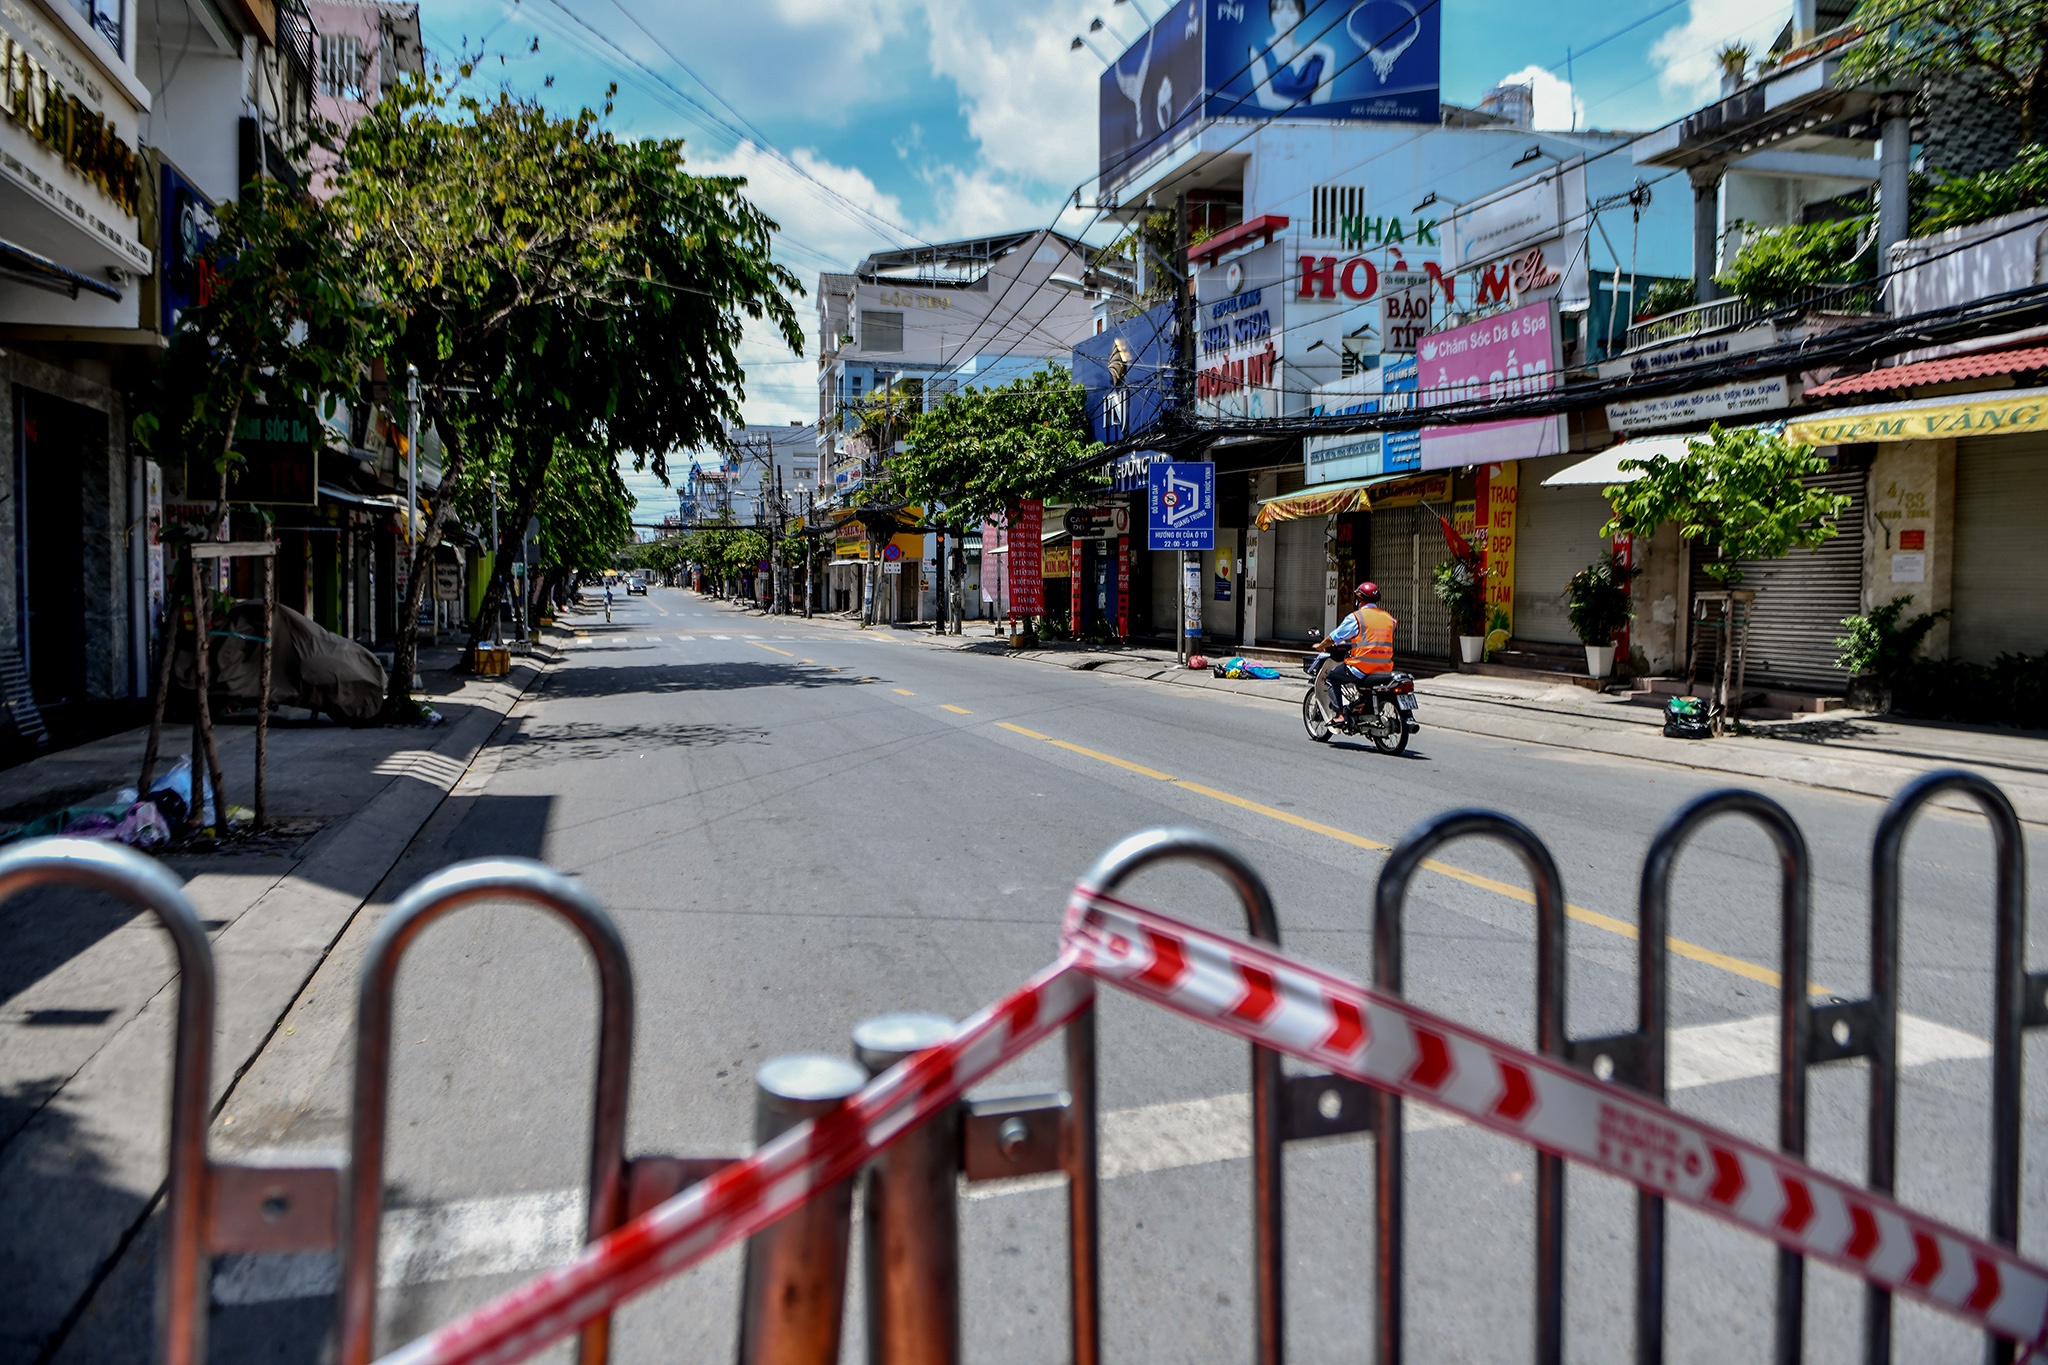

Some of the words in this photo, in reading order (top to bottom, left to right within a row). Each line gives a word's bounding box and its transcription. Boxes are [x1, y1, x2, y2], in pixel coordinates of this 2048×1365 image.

[1341, 215, 1404, 245] NHA
[1386, 290, 1428, 320] BẢO
[1203, 323, 1230, 354] NHA
[1234, 309, 1271, 342] KHOA
[1438, 338, 1468, 358] Chăm
[1470, 331, 1491, 350] Sóc
[1493, 325, 1508, 344] Da
[1510, 319, 1520, 339] &
[1523, 314, 1547, 337] Spa
[1197, 353, 1244, 399] HOÀN
[1102, 390, 1127, 433] PNJ
[1816, 416, 1909, 444] TIỆM
[1924, 405, 2042, 435] VÀNG
[264, 413, 289, 443] SÓC
[1490, 486, 1517, 504] TRAO
[1173, 517, 1190, 529] QUANG
[1190, 509, 1207, 521] TRUNG
[1493, 506, 1512, 529] NÉT
[1176, 531, 1182, 540] ĐI
[1183, 530, 1194, 539] CỦA
[1200, 530, 1208, 539] TÔ
[1492, 535, 1512, 556] ĐẸP
[1490, 581, 1511, 604] TÂM
